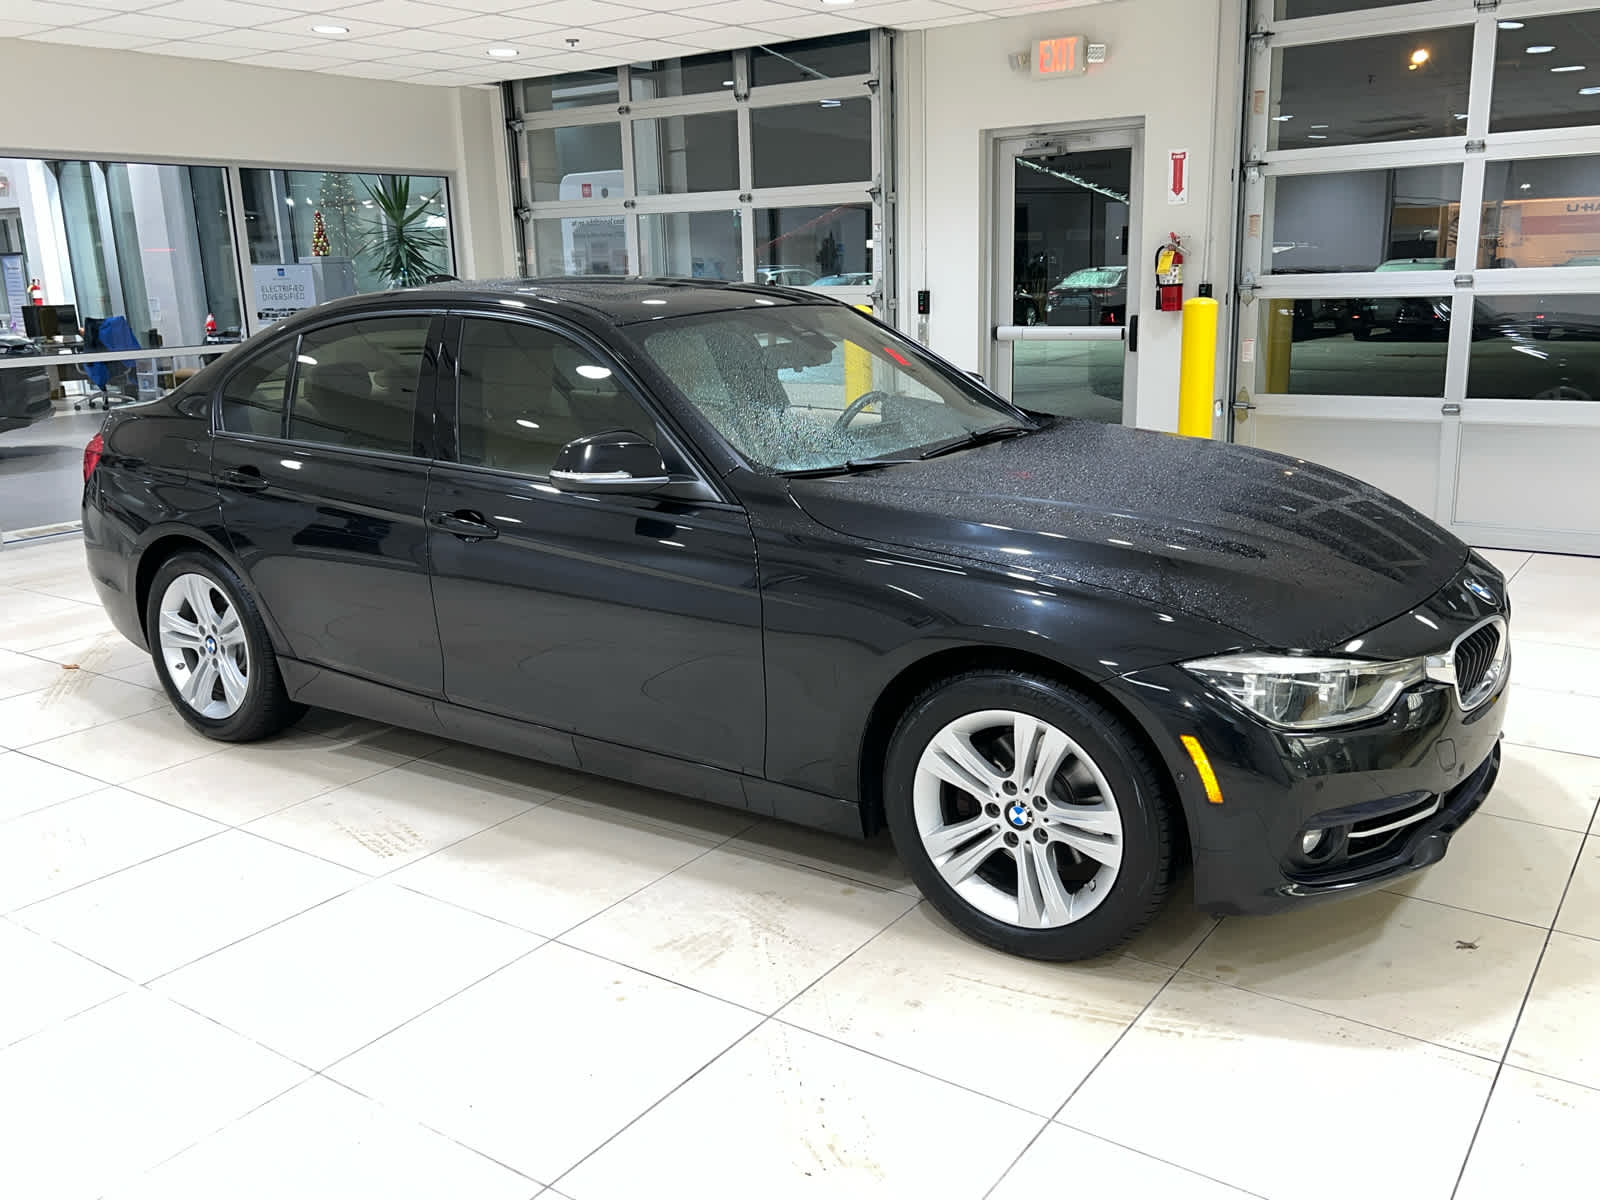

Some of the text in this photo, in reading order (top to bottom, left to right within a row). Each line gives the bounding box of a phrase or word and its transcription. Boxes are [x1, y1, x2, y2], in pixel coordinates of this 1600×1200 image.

[1039, 36, 1078, 73] EXIT
[261, 284, 305, 293] ELECTRIFIED
[262, 292, 305, 301] DIVERSIFIED
